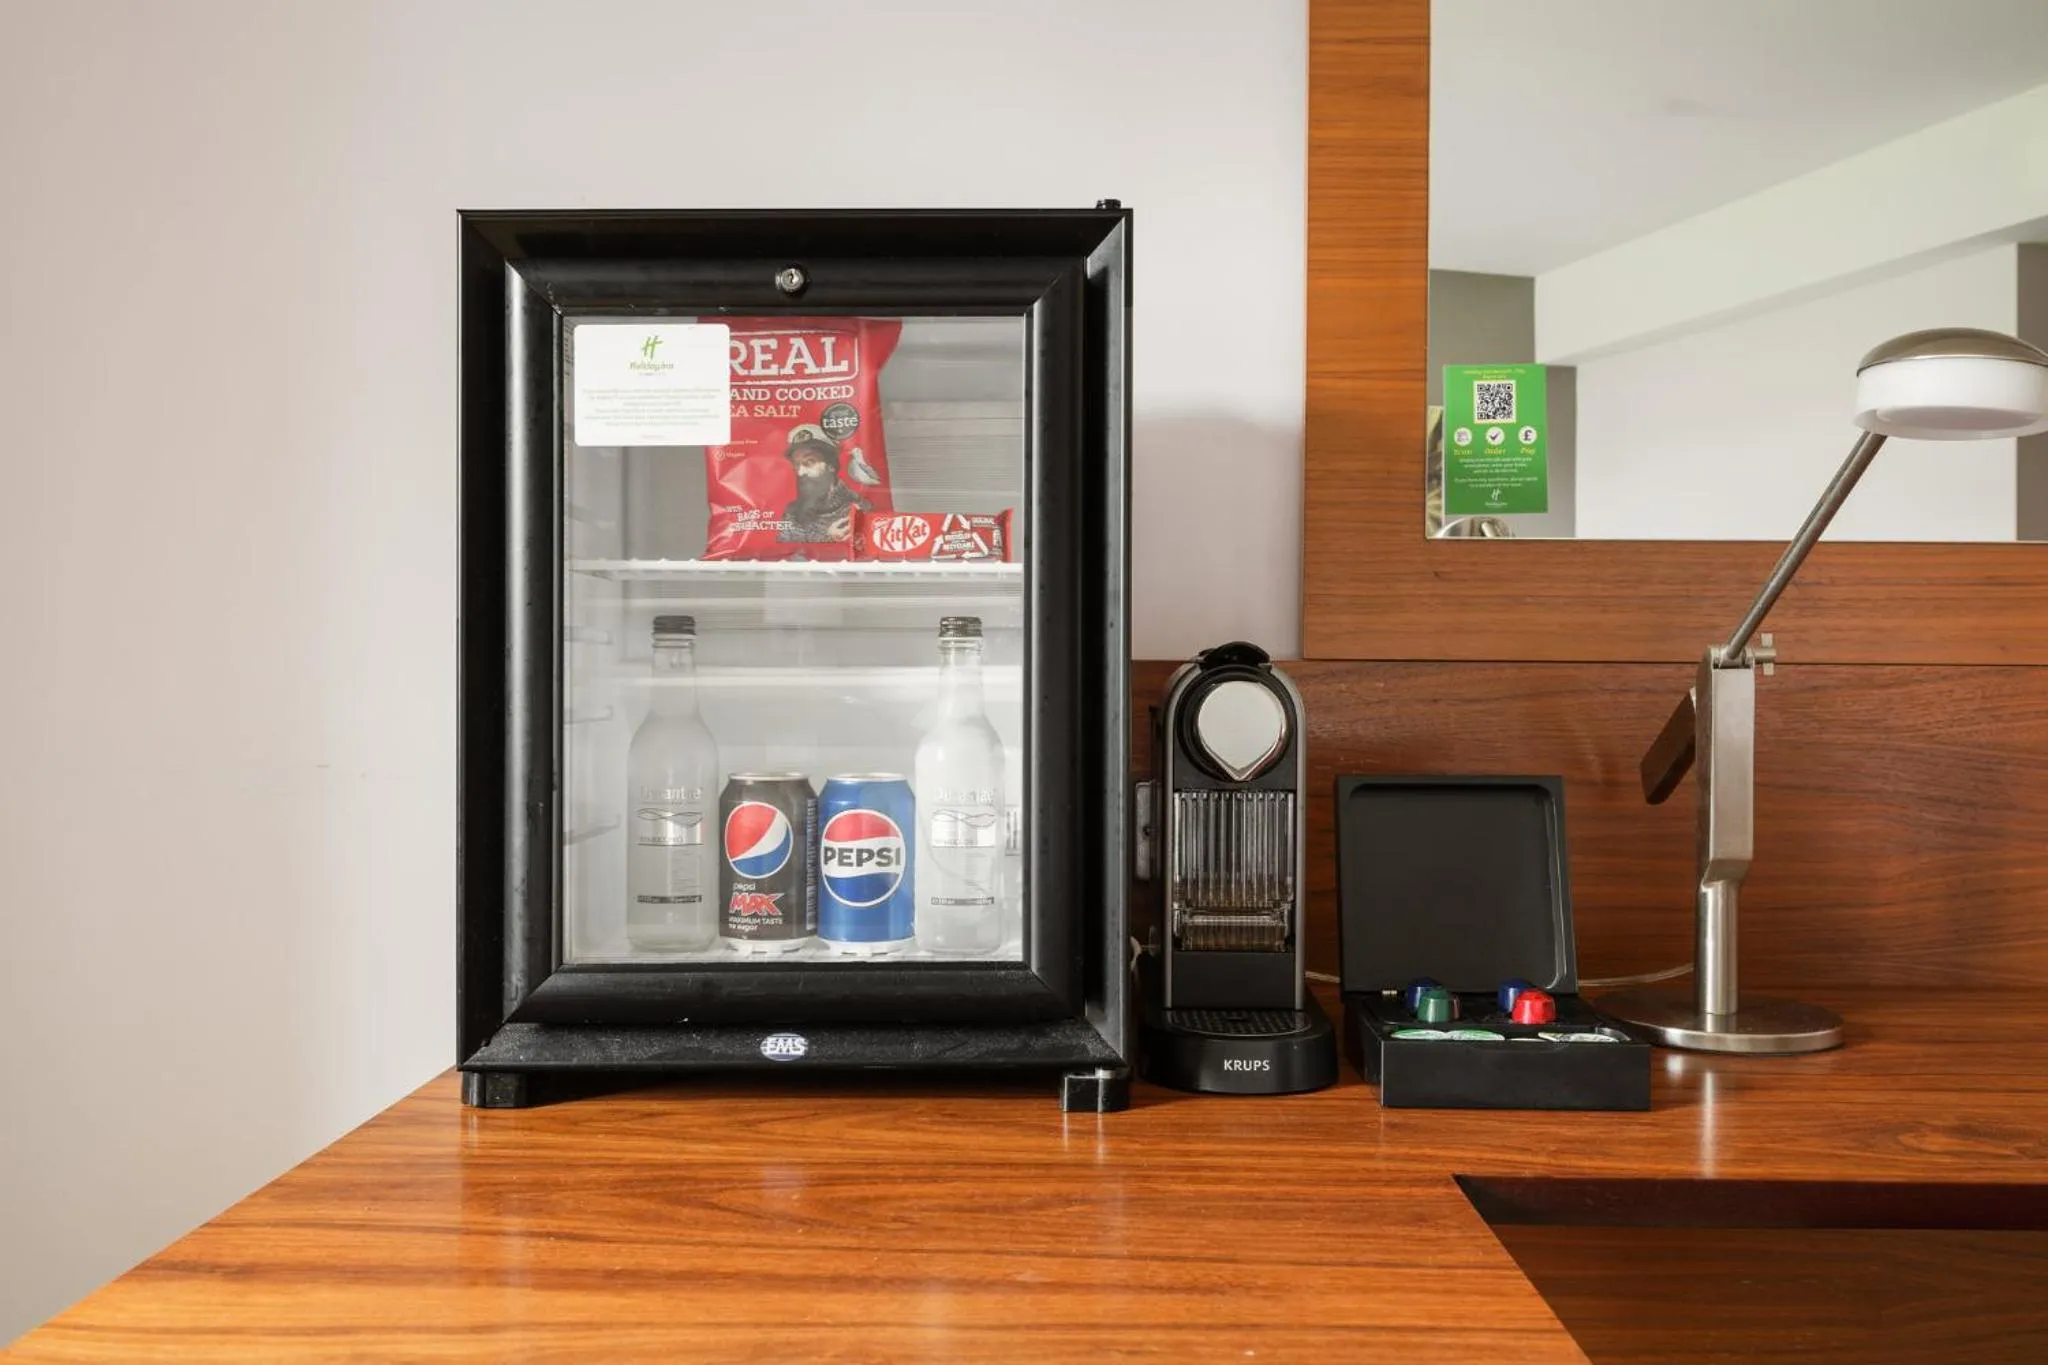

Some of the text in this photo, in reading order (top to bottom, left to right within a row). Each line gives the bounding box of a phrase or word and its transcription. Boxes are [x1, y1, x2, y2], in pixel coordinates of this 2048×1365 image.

[730, 337, 849, 376] REAL
[776, 385, 856, 401] COOKED
[753, 403, 801, 418] SALT
[823, 416, 859, 428] taste
[880, 516, 928, 549] KitKat
[824, 847, 901, 867] PEPSI
[729, 891, 785, 917] MAX
[766, 1037, 808, 1055] EMS
[1224, 1059, 1271, 1071] KRUPS
